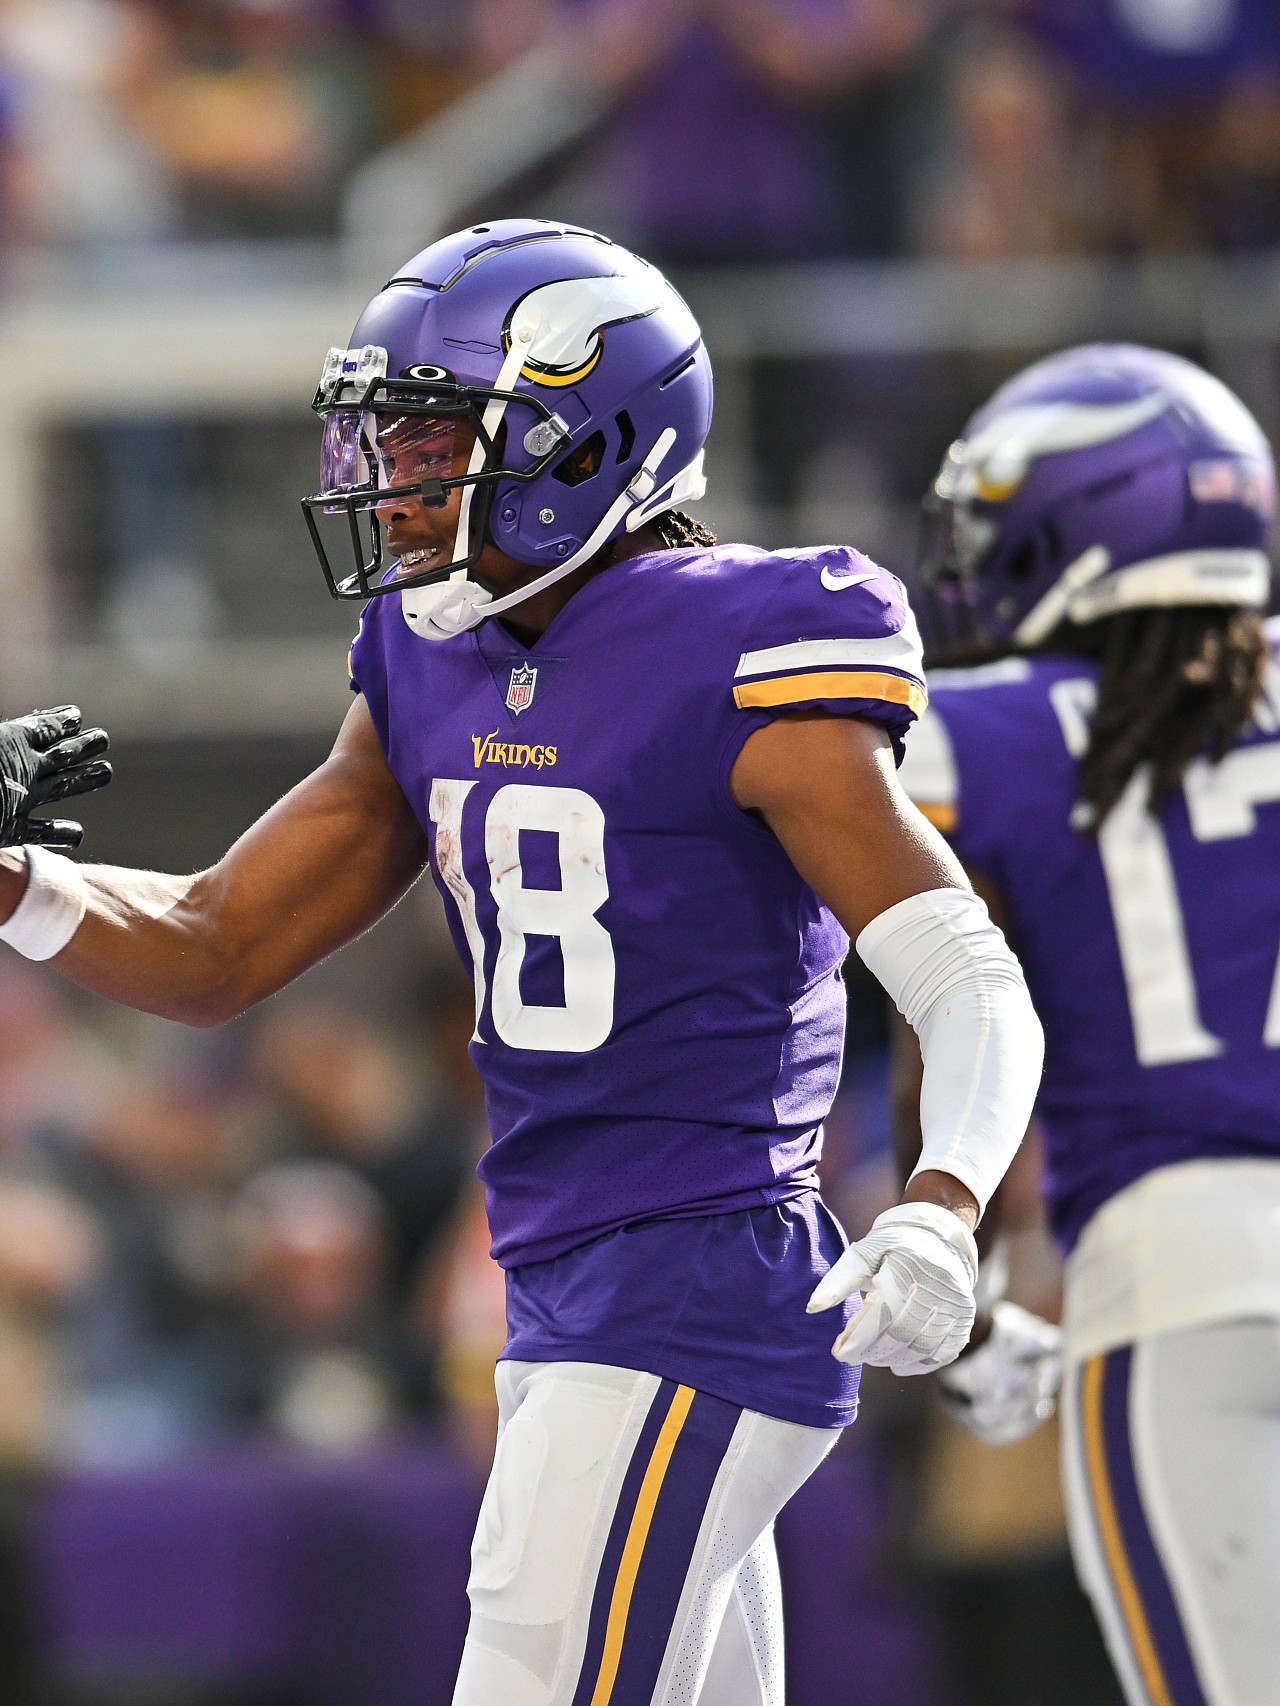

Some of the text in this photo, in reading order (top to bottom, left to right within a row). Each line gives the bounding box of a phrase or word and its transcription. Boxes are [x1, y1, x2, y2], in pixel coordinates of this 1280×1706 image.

[510, 686, 529, 704] NFL
[471, 727, 558, 770] VIKINGS
[429, 778, 616, 1053] 18
